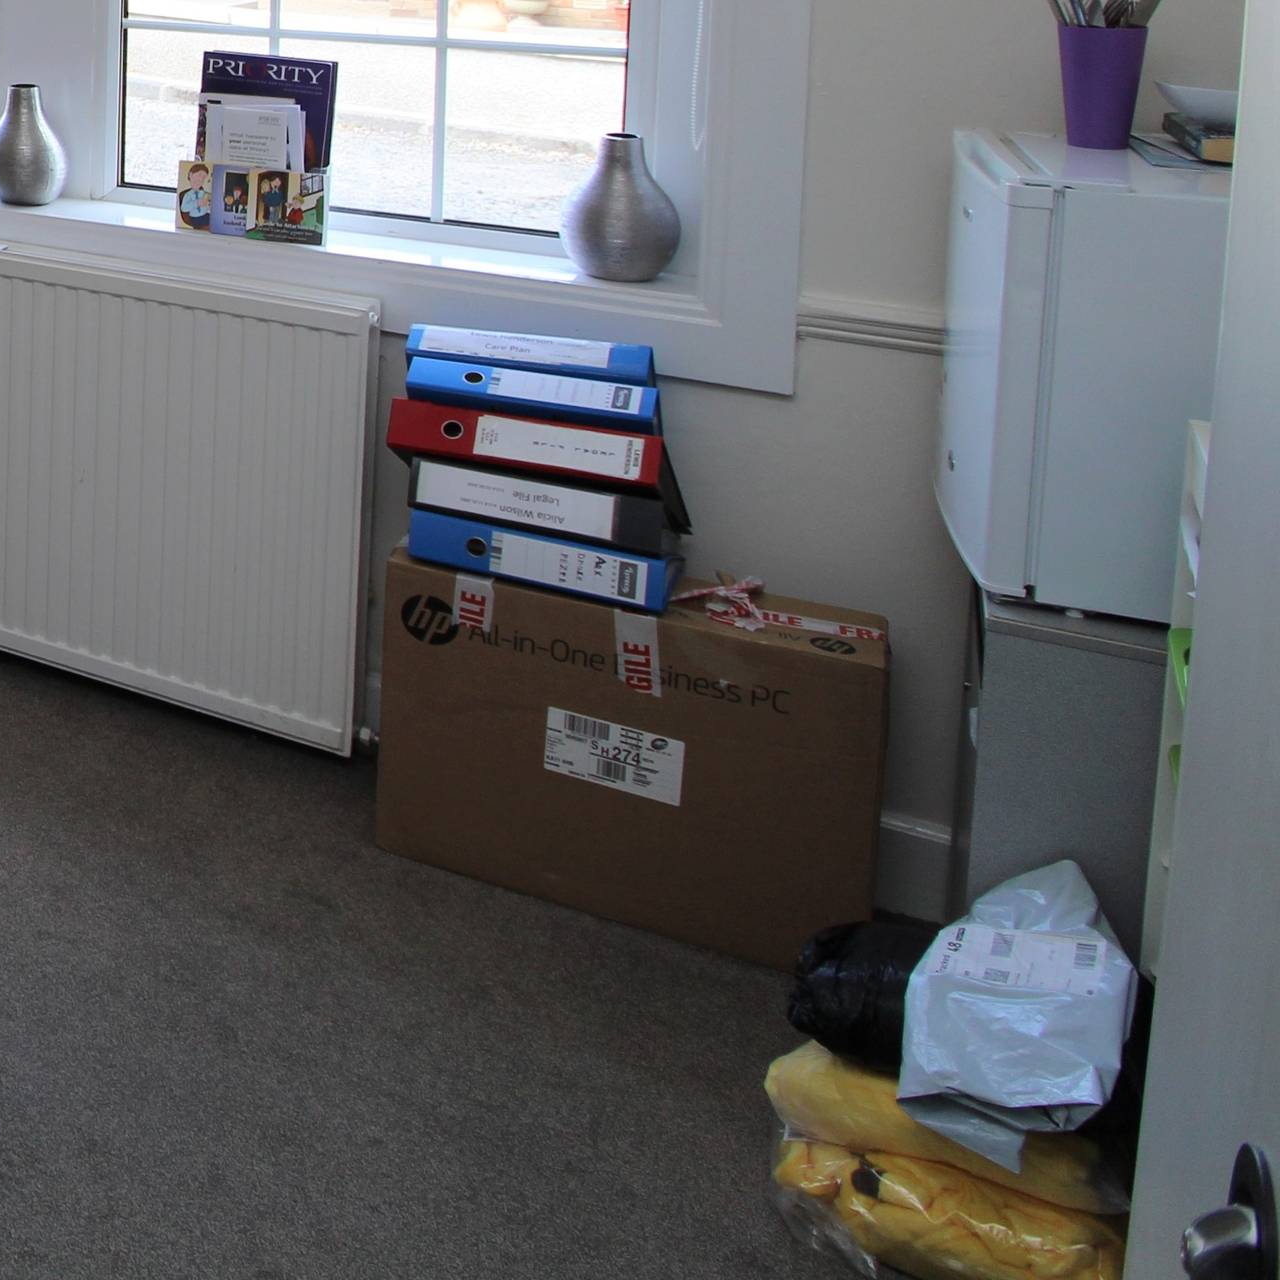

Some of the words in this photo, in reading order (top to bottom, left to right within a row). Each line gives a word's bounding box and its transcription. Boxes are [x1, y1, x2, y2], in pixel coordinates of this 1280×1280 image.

[207, 58, 324, 85] PRIORITY
[484, 342, 508, 351] Care
[509, 346, 531, 355] Plan
[623, 439, 633, 475] HENDERSON
[632, 449, 641, 468] LEWIS
[512, 490, 531, 502] File
[532, 494, 560, 508] Legal
[499, 504, 535, 520] Wilson
[537, 511, 566, 524] Alicia
[405, 595, 456, 644] hp
[752, 684, 791, 715] PC
[591, 740, 599, 750] S
[601, 747, 610, 757] H
[611, 746, 641, 764] 274
[947, 941, 963, 952] 48
